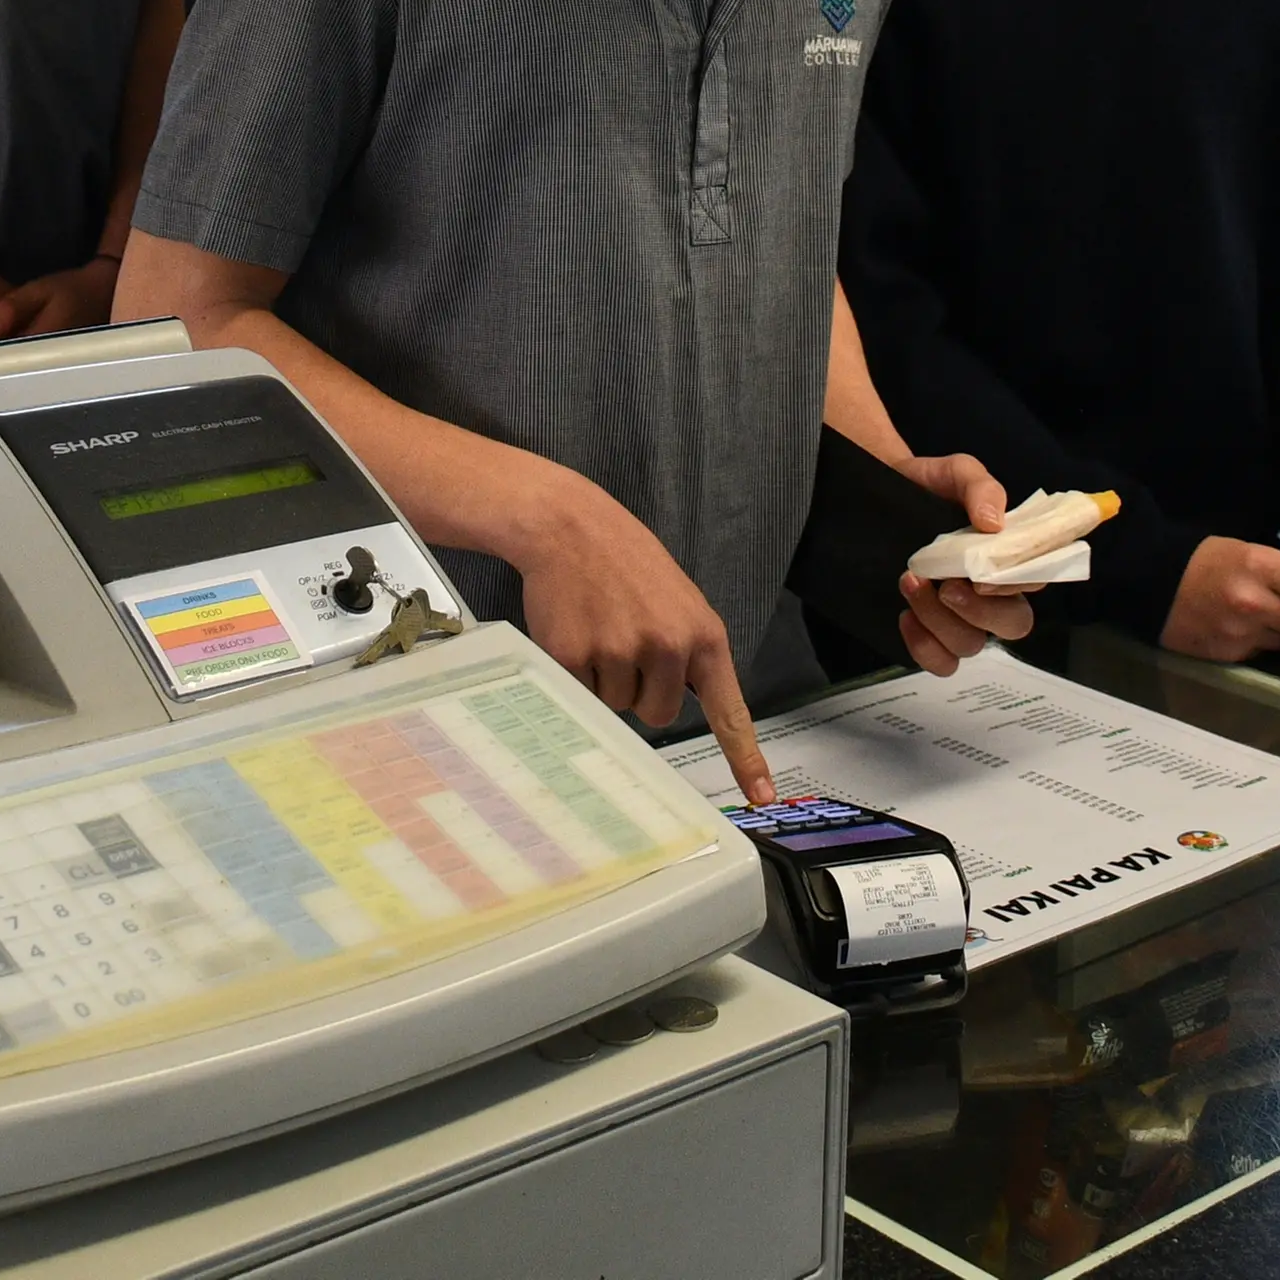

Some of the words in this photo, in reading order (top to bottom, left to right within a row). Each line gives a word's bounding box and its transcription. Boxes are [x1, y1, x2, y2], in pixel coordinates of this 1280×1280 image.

[151, 425, 201, 438] ELECTRONIC
[201, 422, 223, 430] CASH
[223, 415, 262, 426] REGISTER
[50, 431, 139, 455] SHARP
[324, 561, 343, 571] REG
[298, 577, 312, 586] OP
[182, 592, 217, 605] DRINKS
[196, 608, 223, 620] FOOD
[317, 611, 337, 621] PGM
[201, 623, 236, 636] TREATS
[201, 643, 216, 654] ICE
[219, 636, 255, 651] BLOCKS
[206, 658, 237, 674] ORDER
[238, 654, 260, 666] ONLY
[262, 647, 288, 661] FOOD
[1107, 847, 1172, 872] KA
[68, 862, 105, 881] CL
[1049, 867, 1122, 897] PAI
[4, 915, 20, 931] 7
[53, 904, 70, 919] 8
[98, 892, 115, 907] 9
[982, 891, 1061, 923] KAI
[29, 944, 46, 959] 4
[74, 932, 92, 947] 5
[122, 919, 140, 934] 6
[97, 961, 117, 976] 2
[144, 948, 163, 963] 3
[74, 1002, 91, 1018] 0
